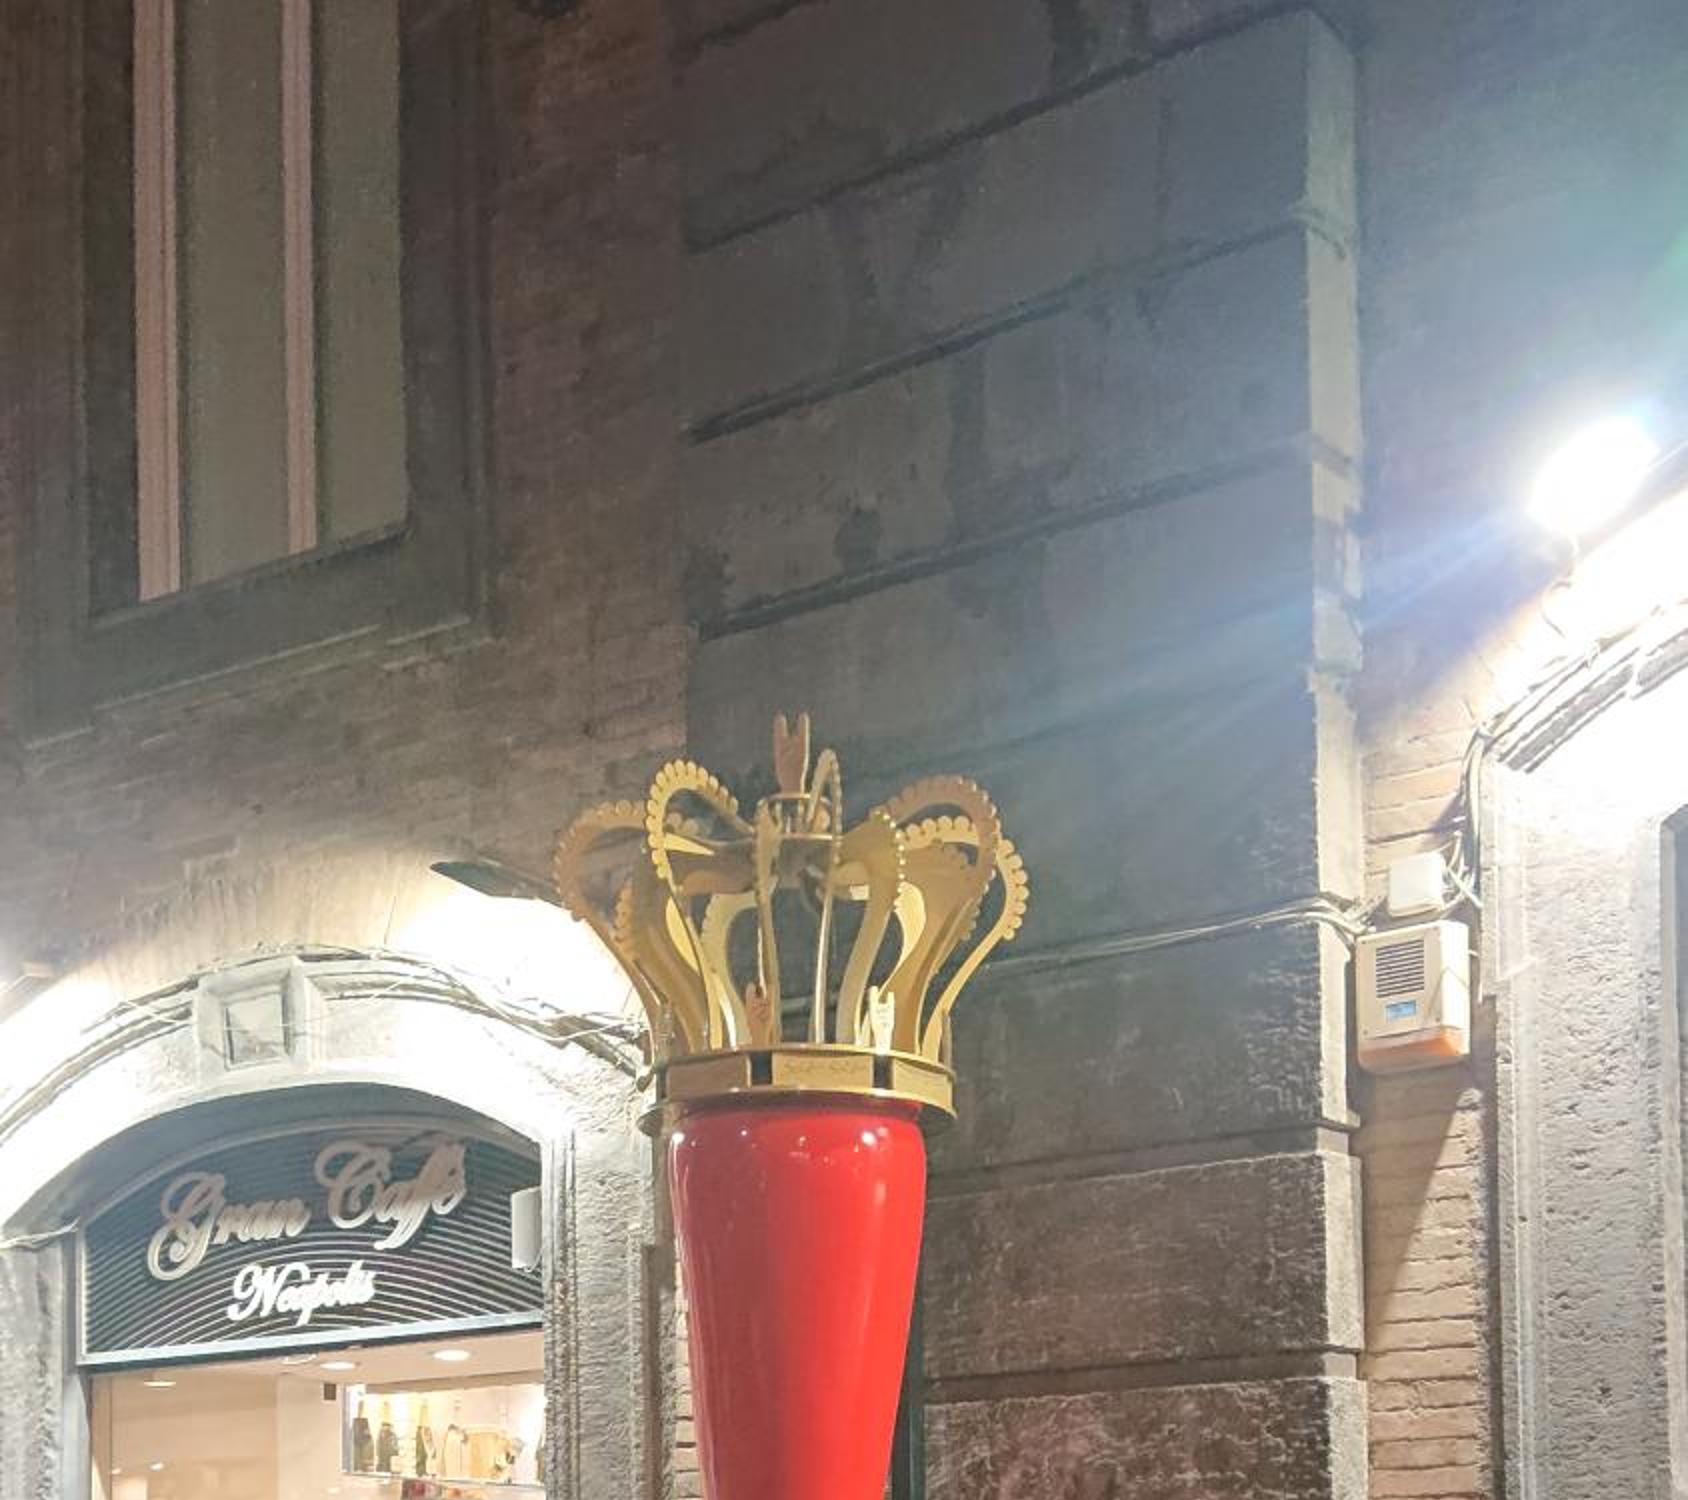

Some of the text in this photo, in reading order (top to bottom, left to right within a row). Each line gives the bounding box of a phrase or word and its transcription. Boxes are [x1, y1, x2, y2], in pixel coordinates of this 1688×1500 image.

[147, 1131, 467, 1281] Gran Café
[226, 1260, 378, 1326] Neapolis
